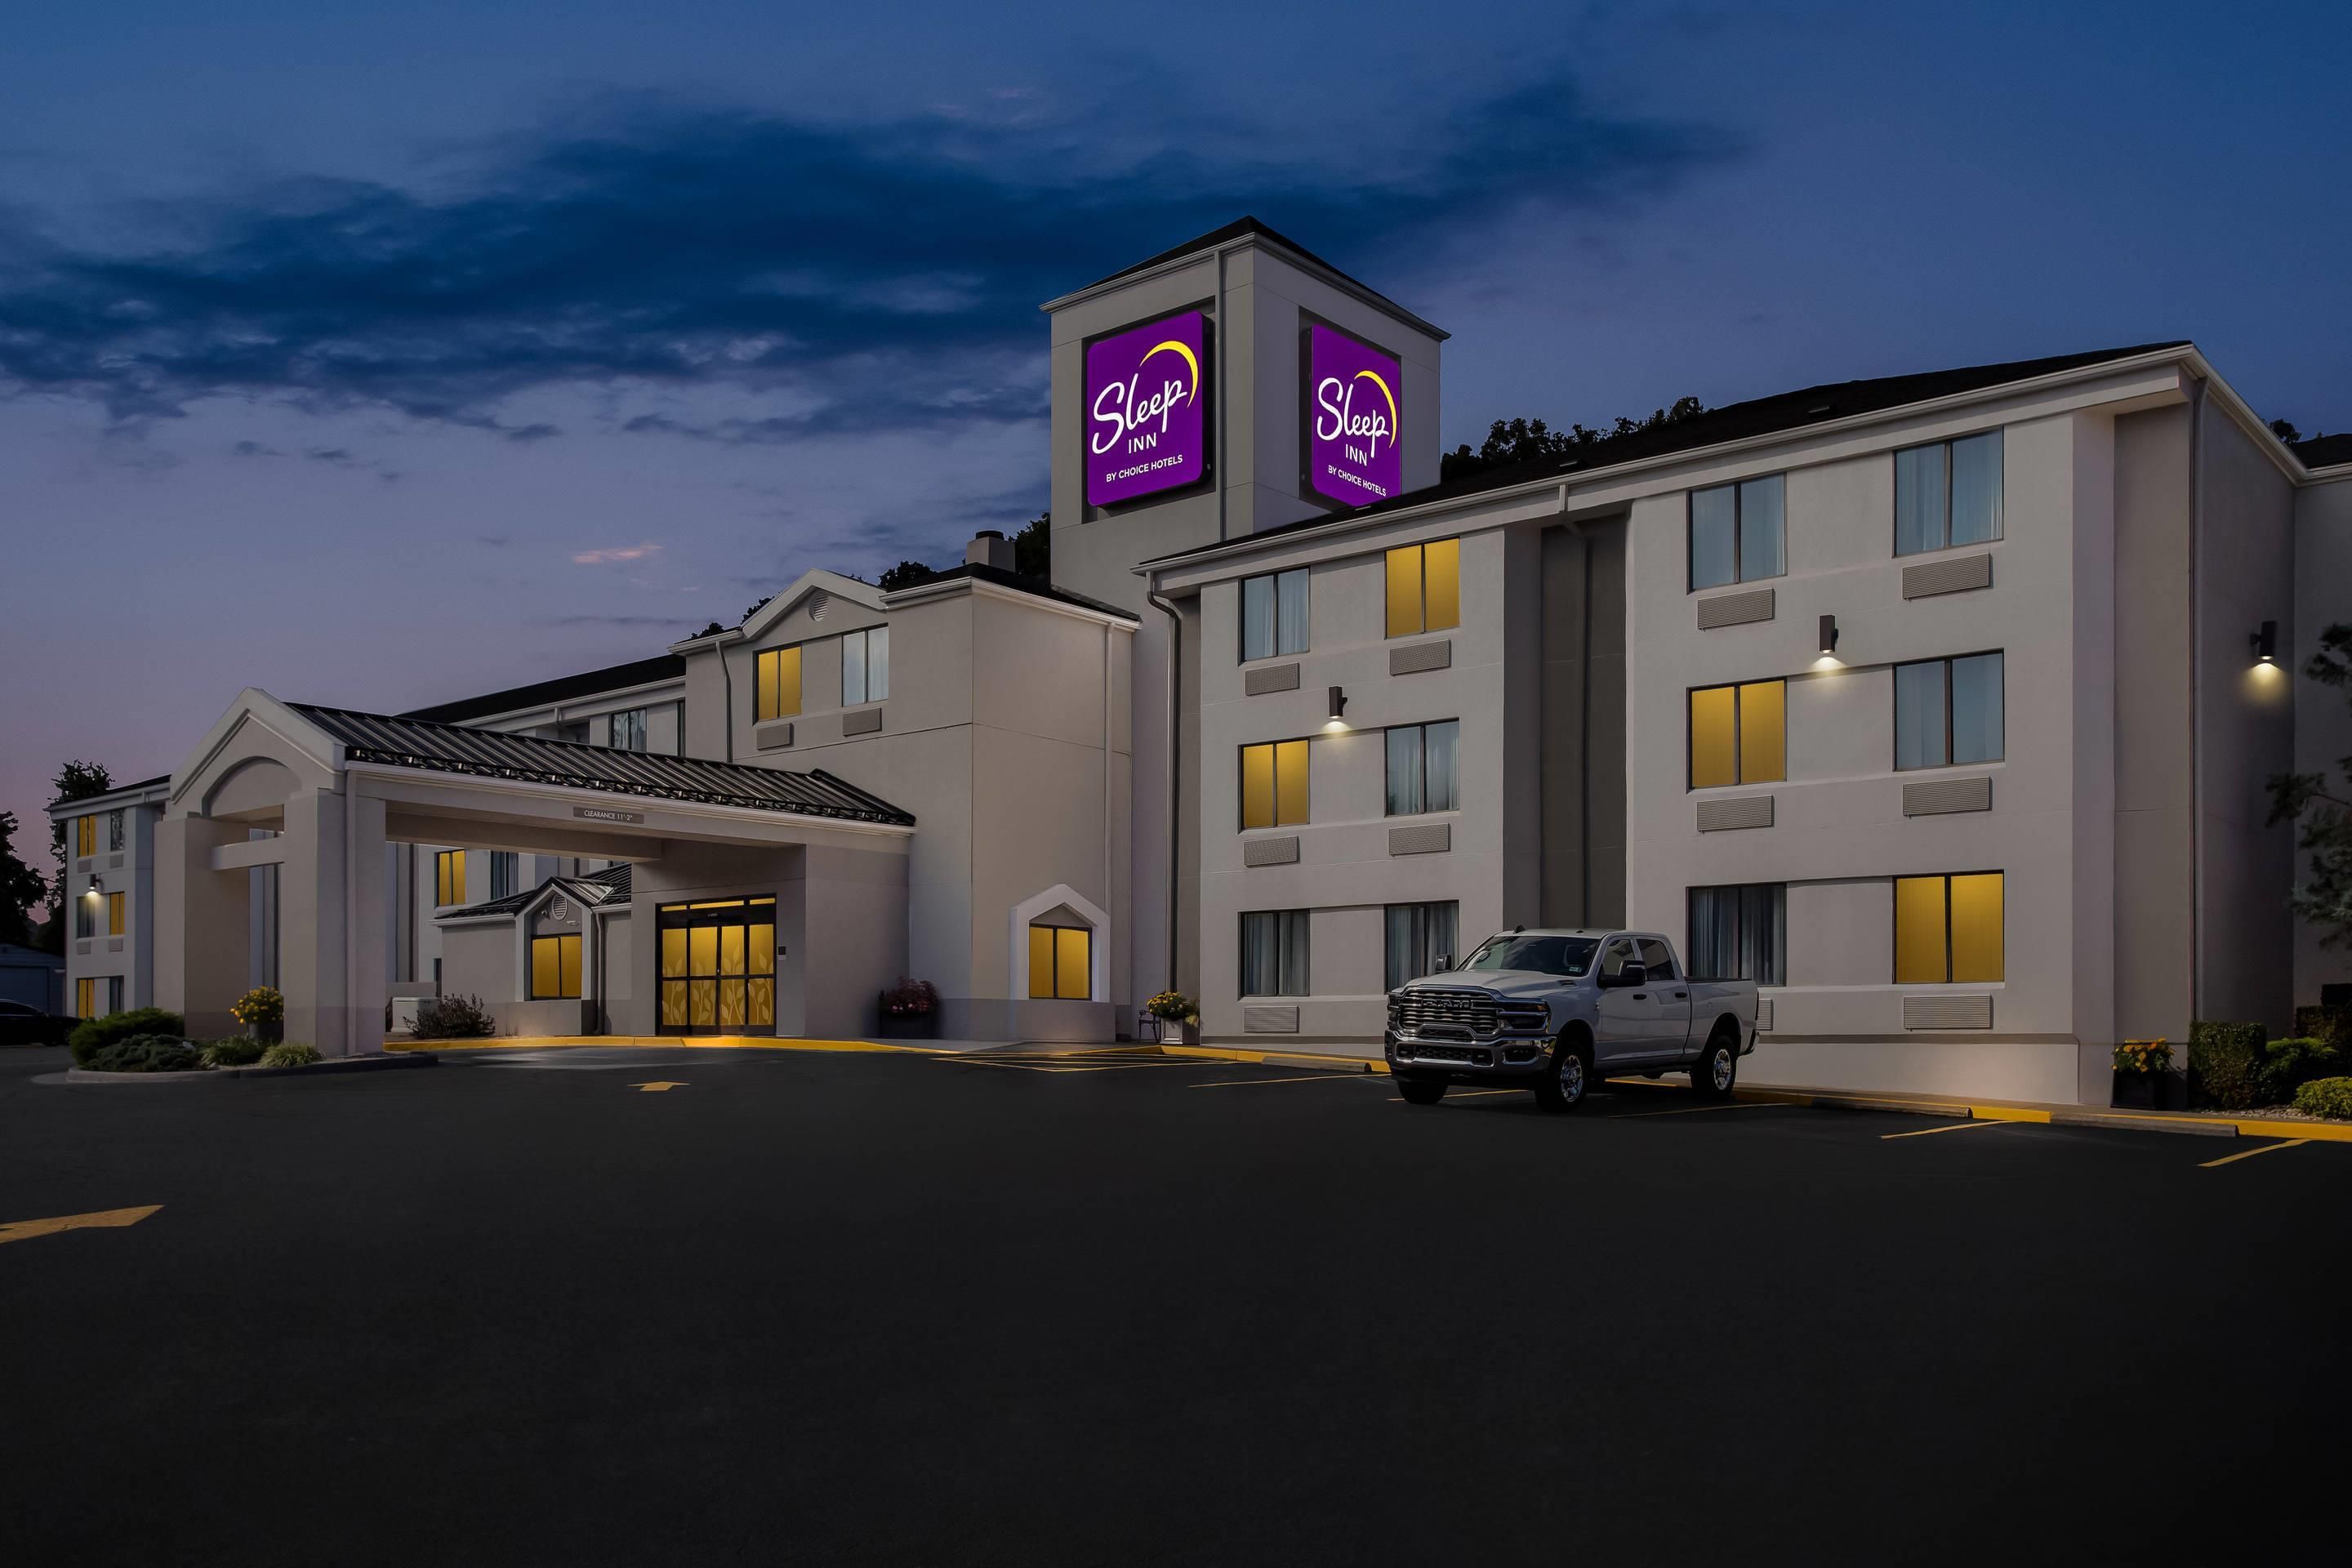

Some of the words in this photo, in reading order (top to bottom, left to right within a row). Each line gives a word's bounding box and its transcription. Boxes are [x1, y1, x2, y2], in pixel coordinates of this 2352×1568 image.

[1092, 372, 1187, 454] Sleep
[1316, 377, 1390, 458] Sleep
[1128, 432, 1157, 454] INN
[1345, 443, 1368, 467] INN
[1106, 472, 1117, 483] BY
[1118, 463, 1149, 479] CHOICE
[1151, 454, 1183, 470] HOTELS
[1328, 465, 1337, 475] BY
[1338, 469, 1362, 487] CHOICE
[1362, 479, 1387, 497] HOTELS
[584, 809, 616, 820] CLEARANCE
